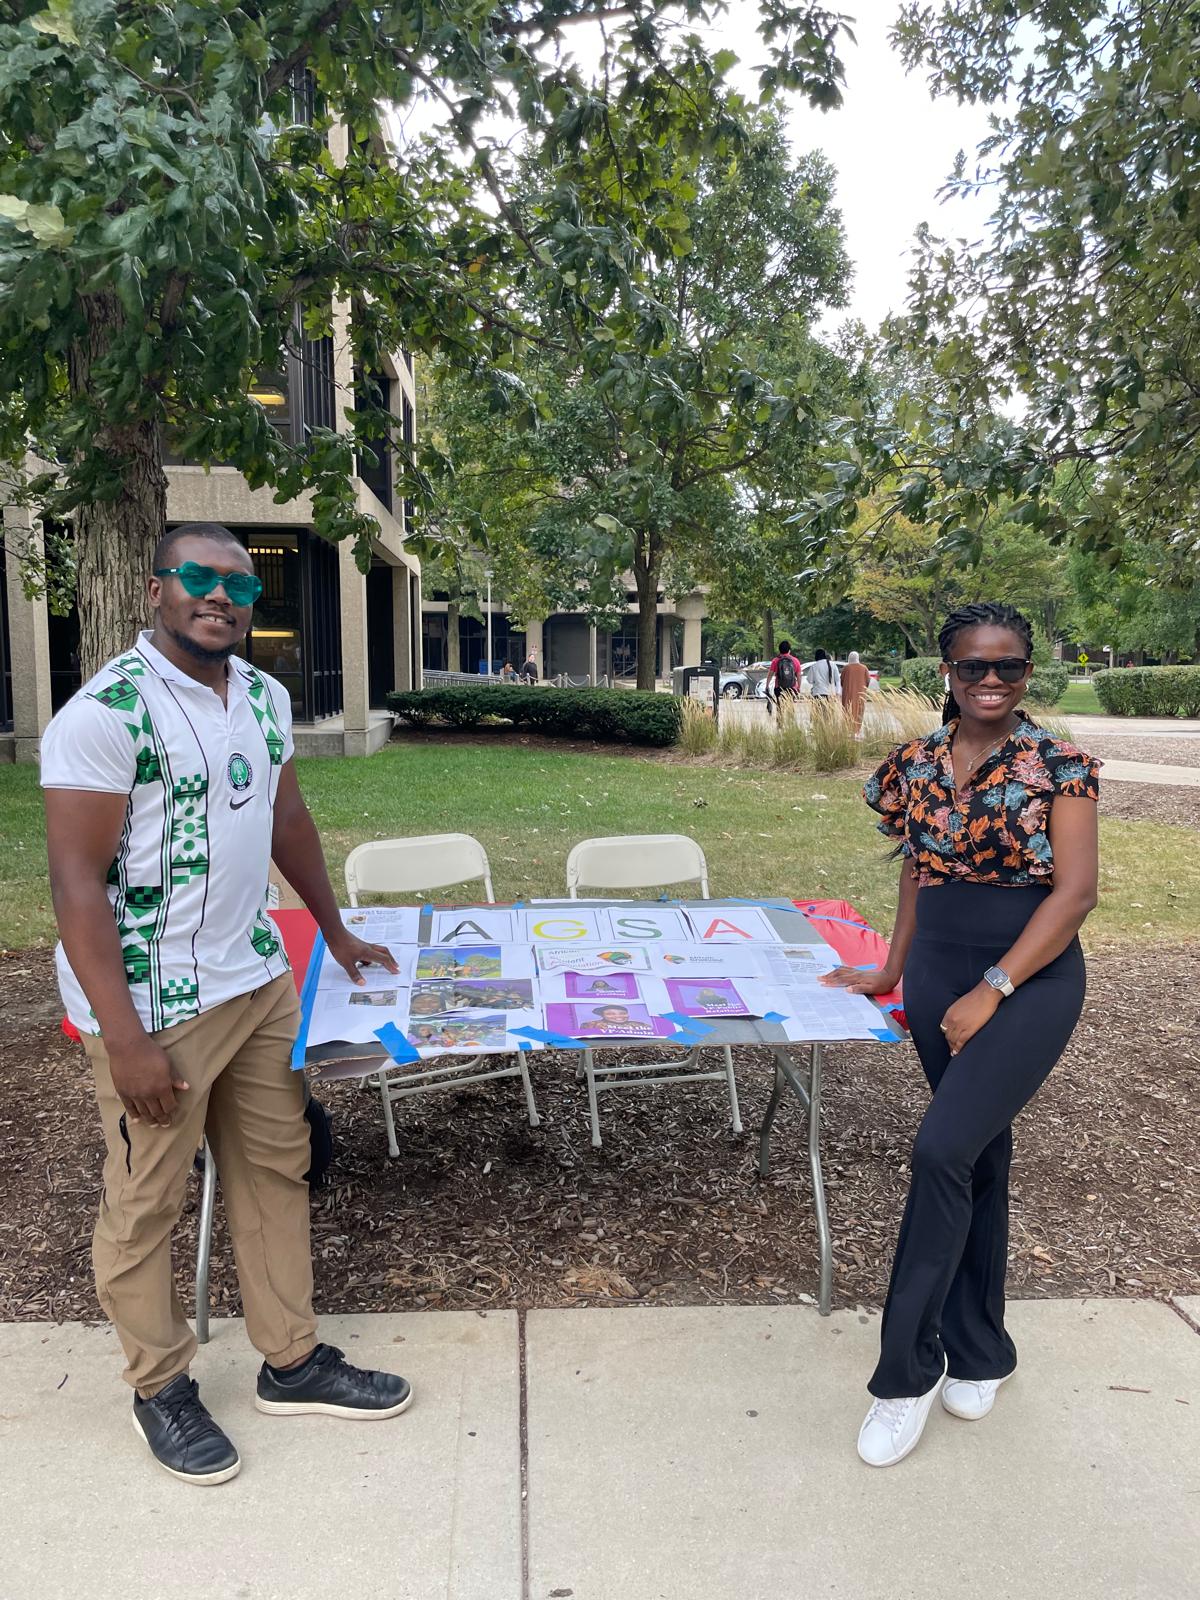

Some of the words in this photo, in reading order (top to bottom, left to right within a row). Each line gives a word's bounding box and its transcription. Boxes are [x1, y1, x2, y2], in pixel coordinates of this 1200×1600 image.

[440, 920, 493, 942] A
[533, 919, 588, 940] G
[617, 918, 663, 939] S
[703, 918, 753, 939] A
